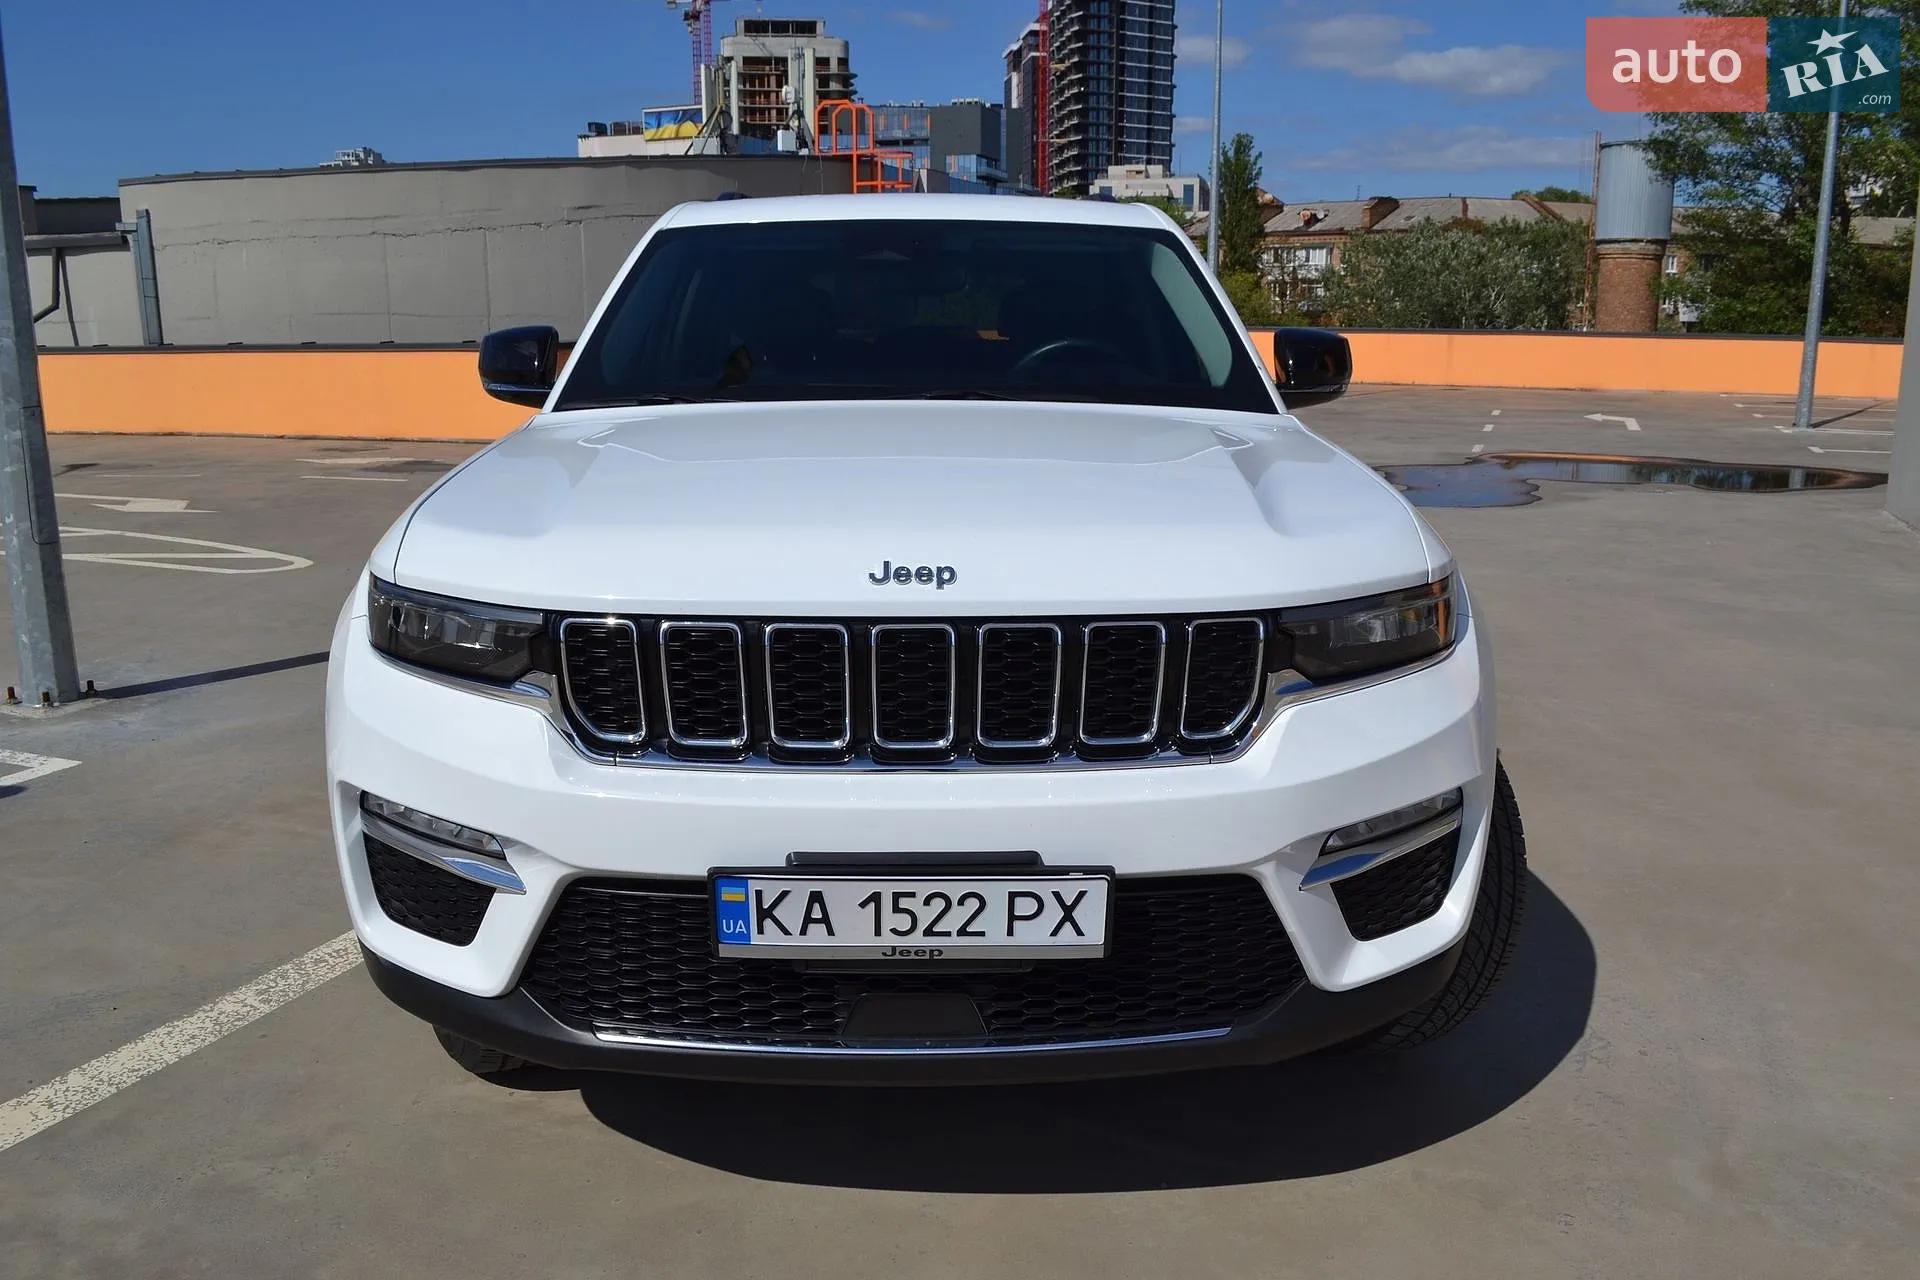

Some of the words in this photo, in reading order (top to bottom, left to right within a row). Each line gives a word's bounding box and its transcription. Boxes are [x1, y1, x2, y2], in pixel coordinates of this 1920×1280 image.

[869, 560, 958, 590] Jeep
[754, 888, 835, 938] KA
[857, 890, 987, 939] 1522
[1006, 889, 1089, 938] PX
[722, 919, 747, 935] UA
[881, 946, 943, 960] Jeep
